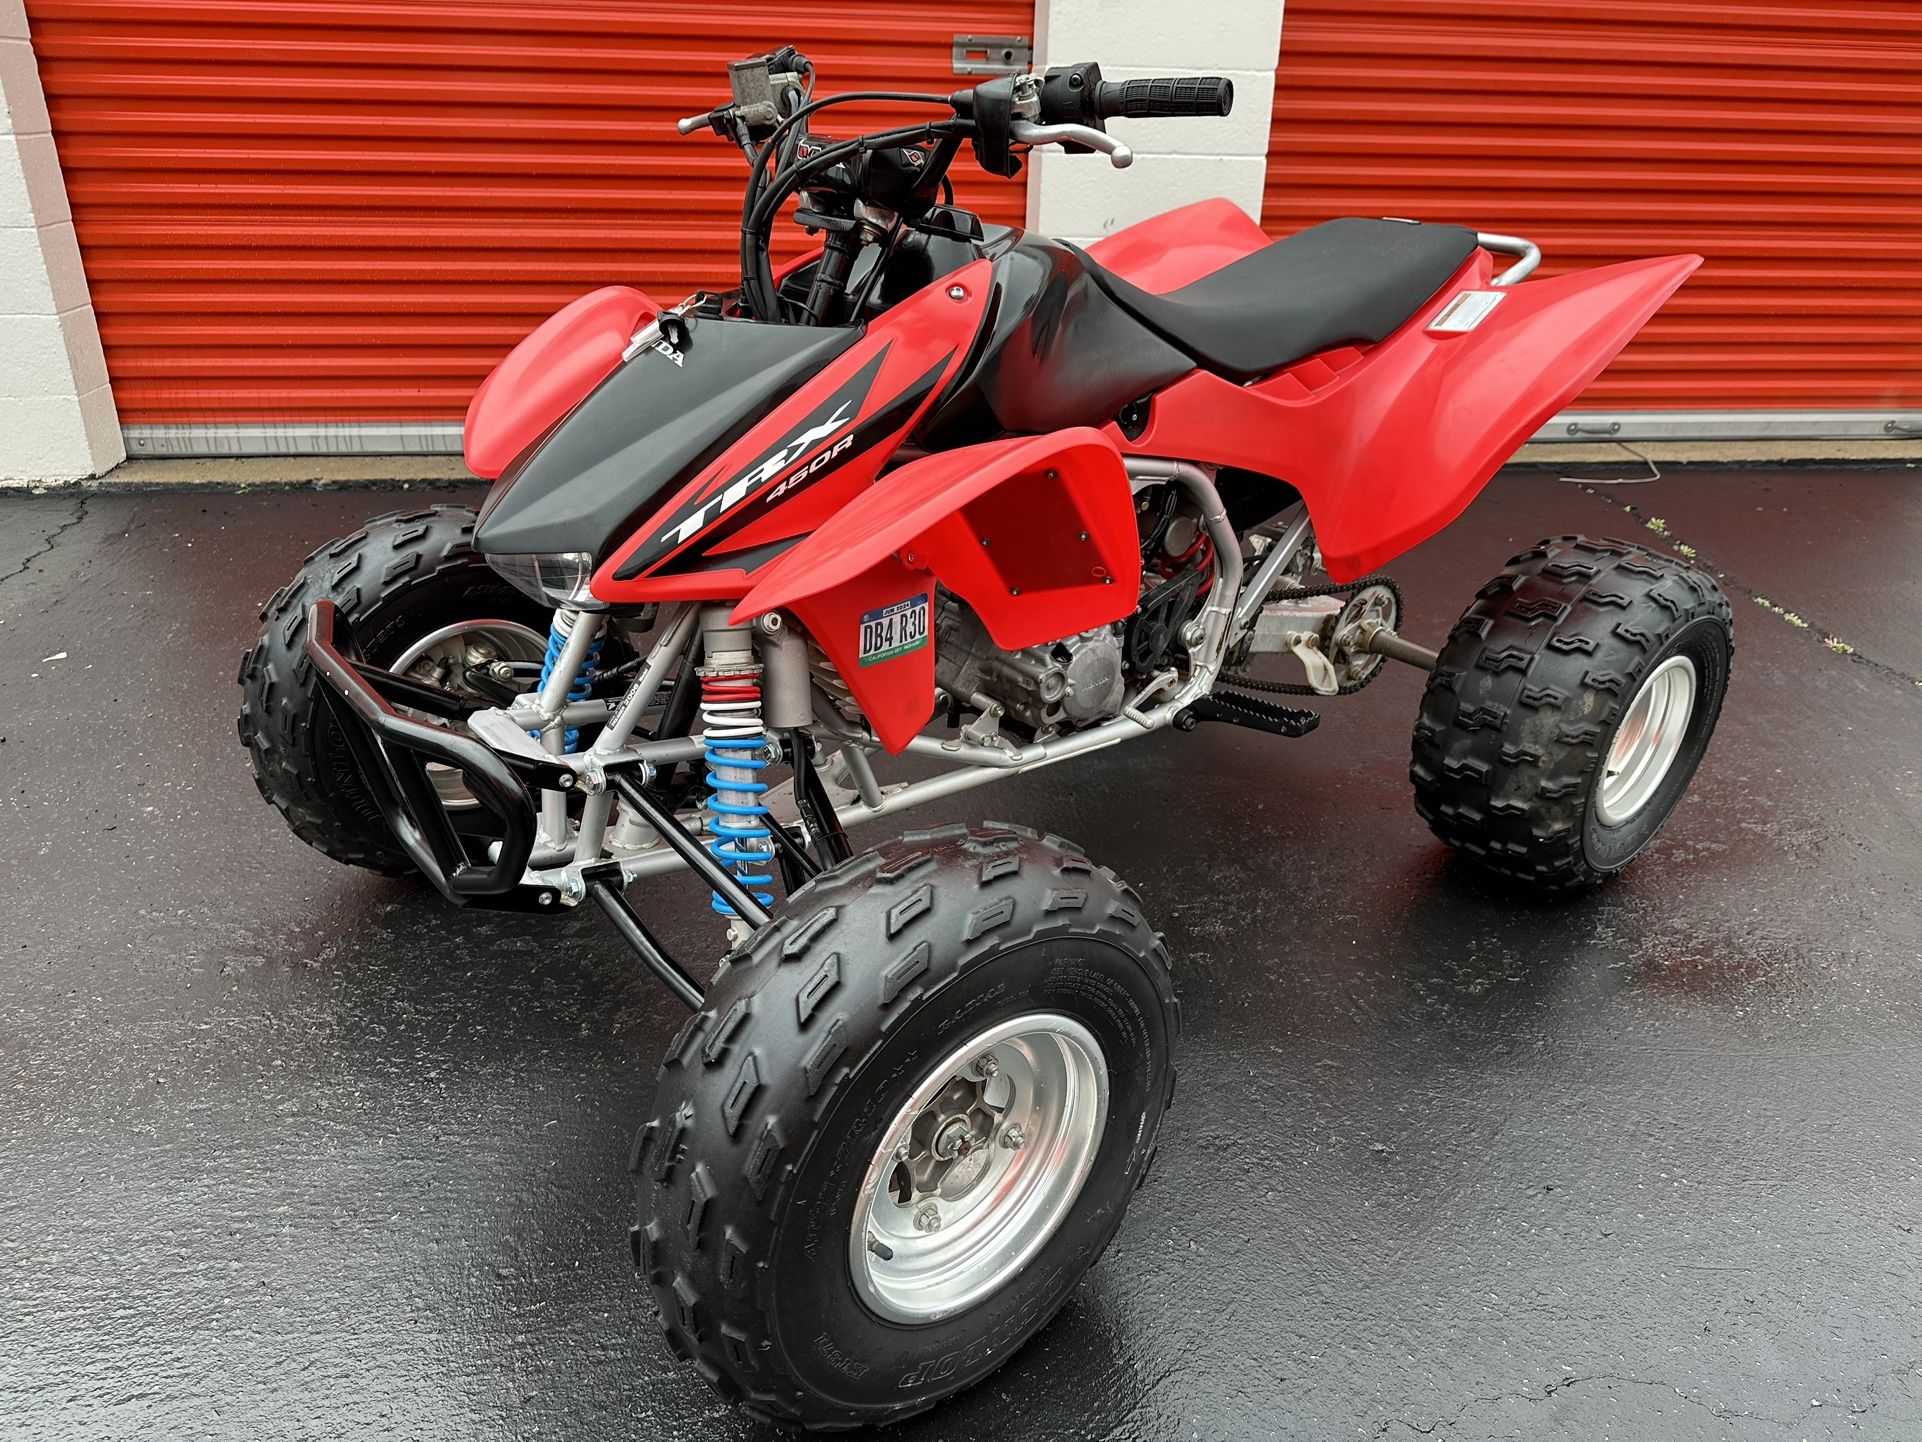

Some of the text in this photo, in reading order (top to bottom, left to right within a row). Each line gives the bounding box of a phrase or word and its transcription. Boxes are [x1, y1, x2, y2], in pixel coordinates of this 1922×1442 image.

[661, 400, 852, 544] TRX
[766, 434, 854, 503] 450R
[863, 606, 926, 655] DB4 R30
